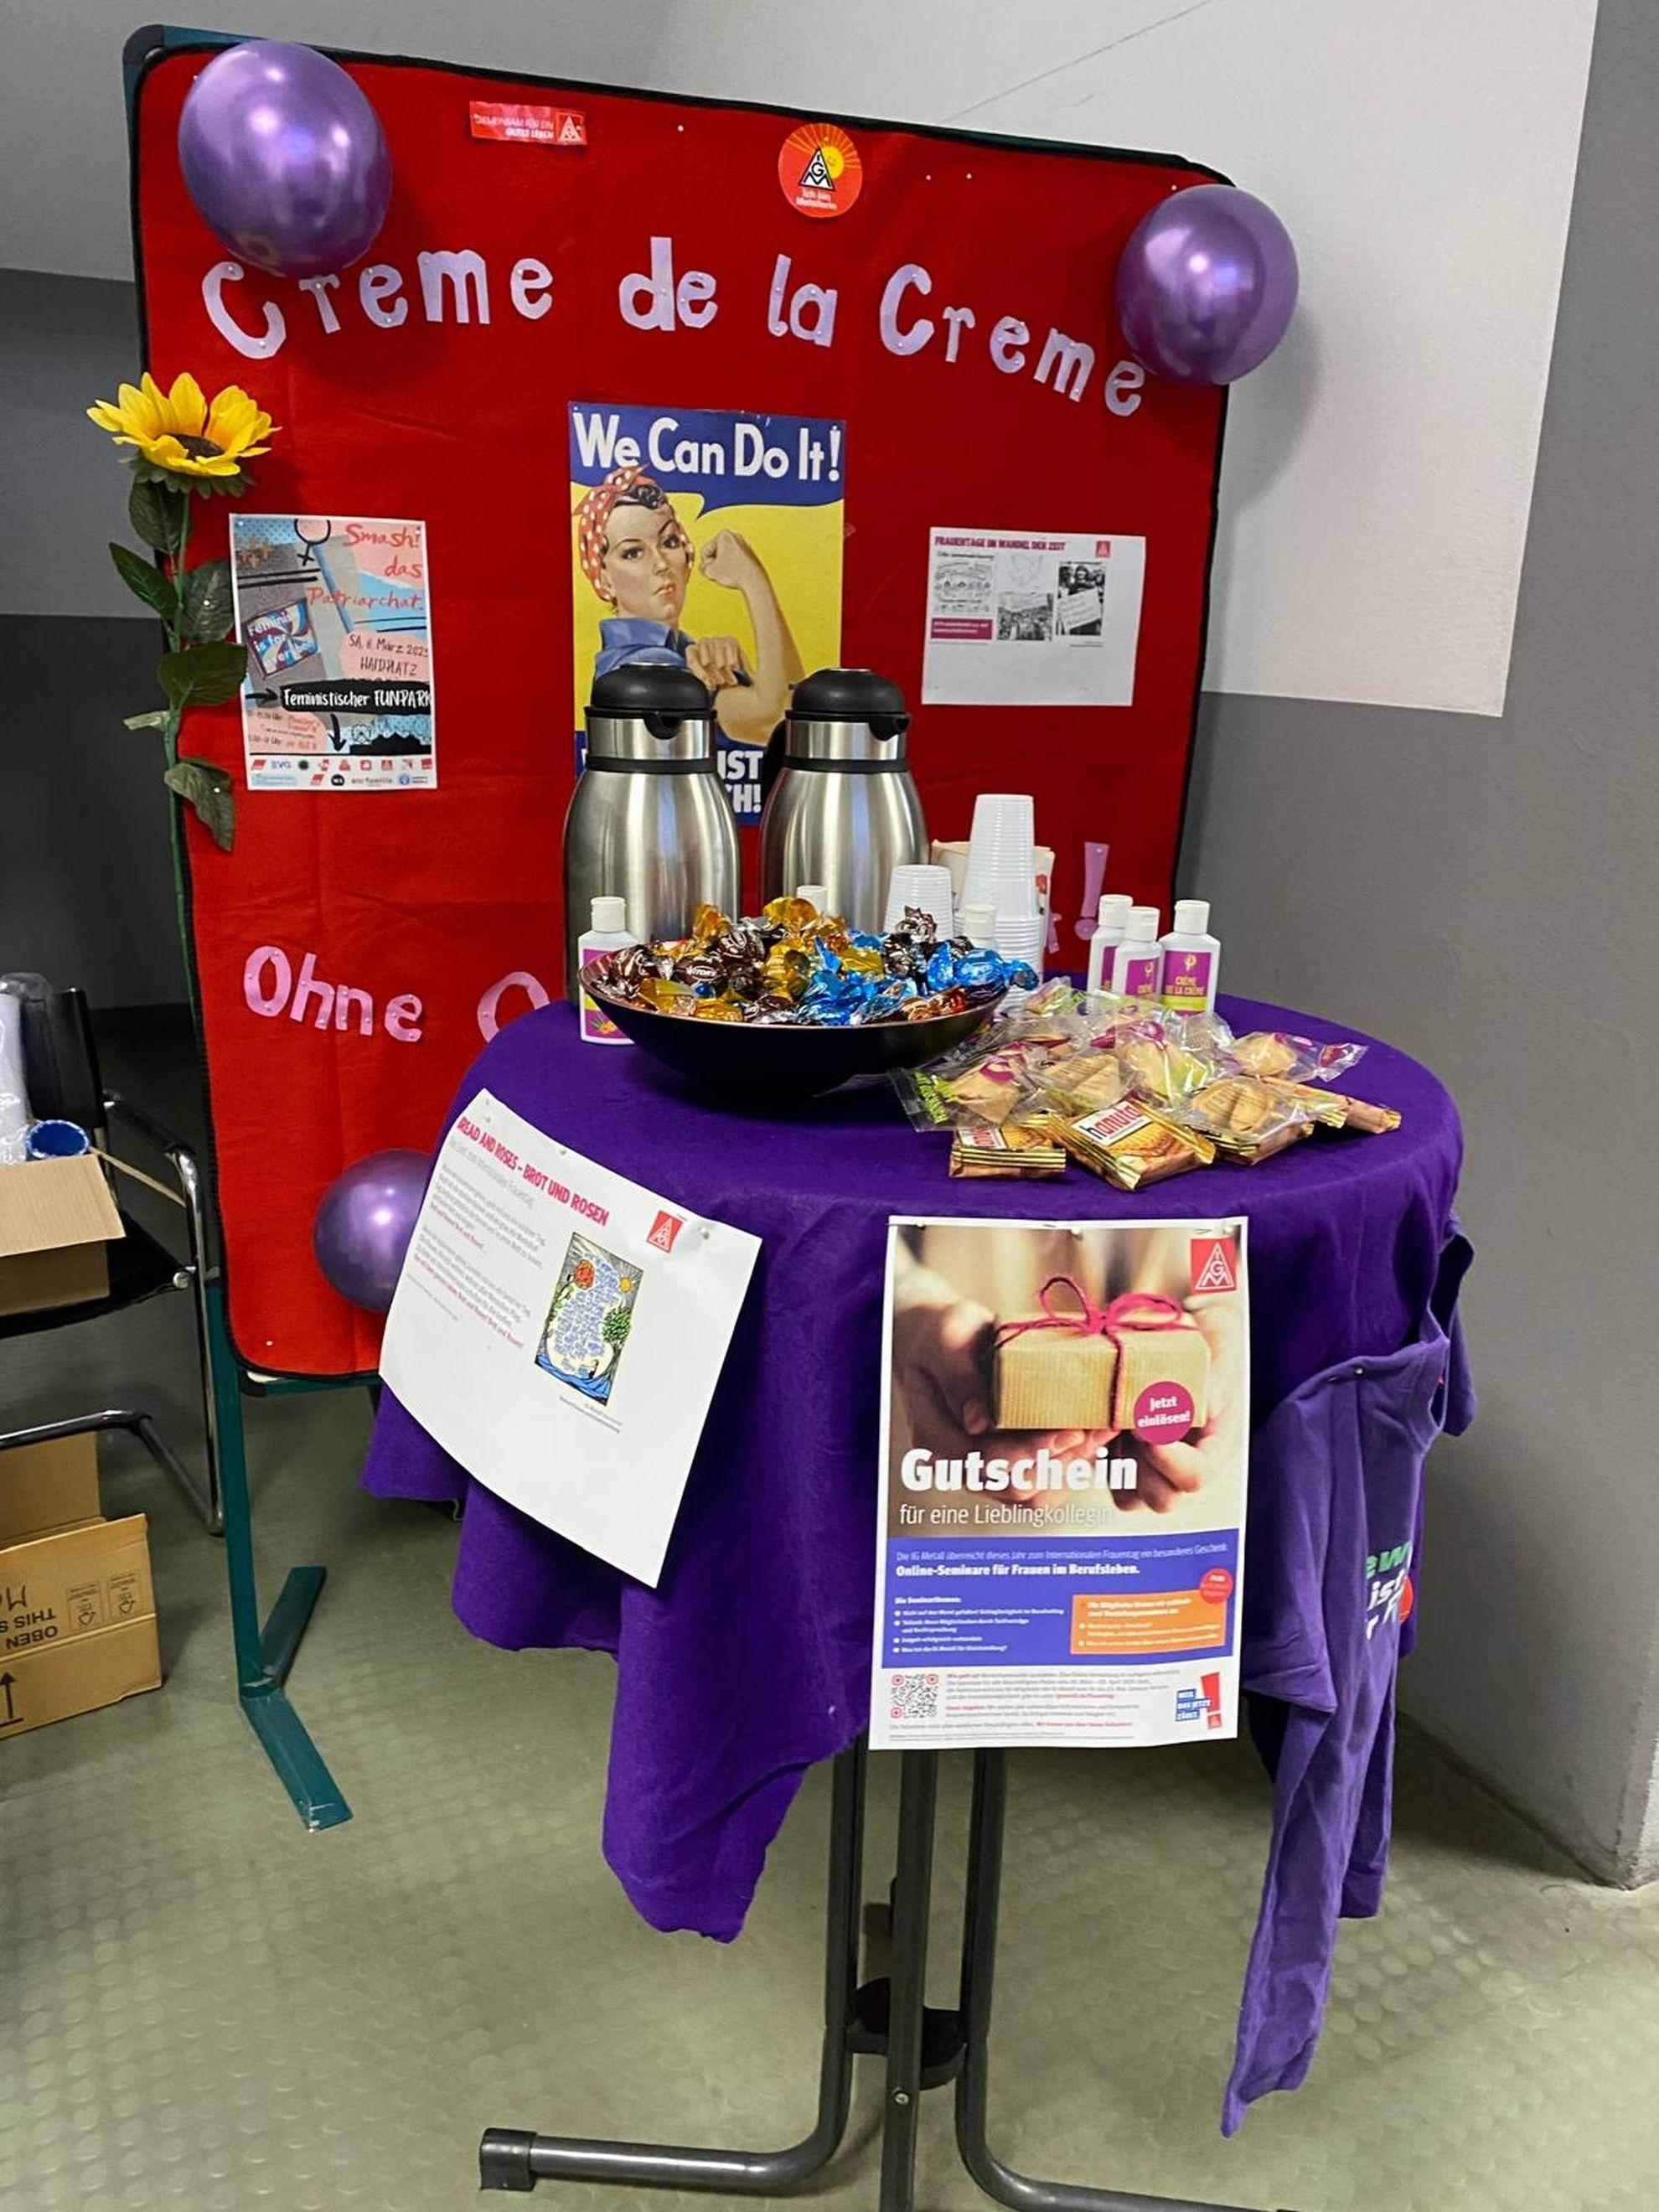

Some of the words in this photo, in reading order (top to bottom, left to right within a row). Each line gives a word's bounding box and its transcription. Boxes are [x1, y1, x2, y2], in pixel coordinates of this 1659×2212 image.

[202, 250, 553, 359] Creme
[618, 237, 717, 331] de
[767, 255, 837, 347] la
[880, 263, 1145, 417] Creme
[572, 412, 640, 468] We
[649, 417, 724, 474] Can
[734, 423, 789, 478] Do
[798, 426, 841, 482] It!
[385, 554, 423, 579] das
[283, 689, 371, 709] Feministischer
[243, 944, 422, 1042] Ohne
[1079, 1103, 1144, 1140] hanuta
[522, 1165, 550, 1193] BROT
[547, 1181, 571, 1207] UND
[571, 1195, 611, 1226] ROSEN
[1150, 1396, 1177, 1412] Jetzt
[1138, 1410, 1191, 1428] einlösen!
[901, 1447, 1137, 1491] Gutschein
[900, 1503, 926, 1525] für
[930, 1506, 969, 1525] eine
[896, 1564, 990, 1577] Online-Seminare
[993, 1563, 1010, 1576] für
[1011, 1563, 1050, 1575] Frauen
[1052, 1563, 1067, 1575] im
[1069, 1563, 1140, 1575] Berufsleben.
[14, 1608, 56, 1630] THIS
[5, 1625, 58, 1650] OBEN
